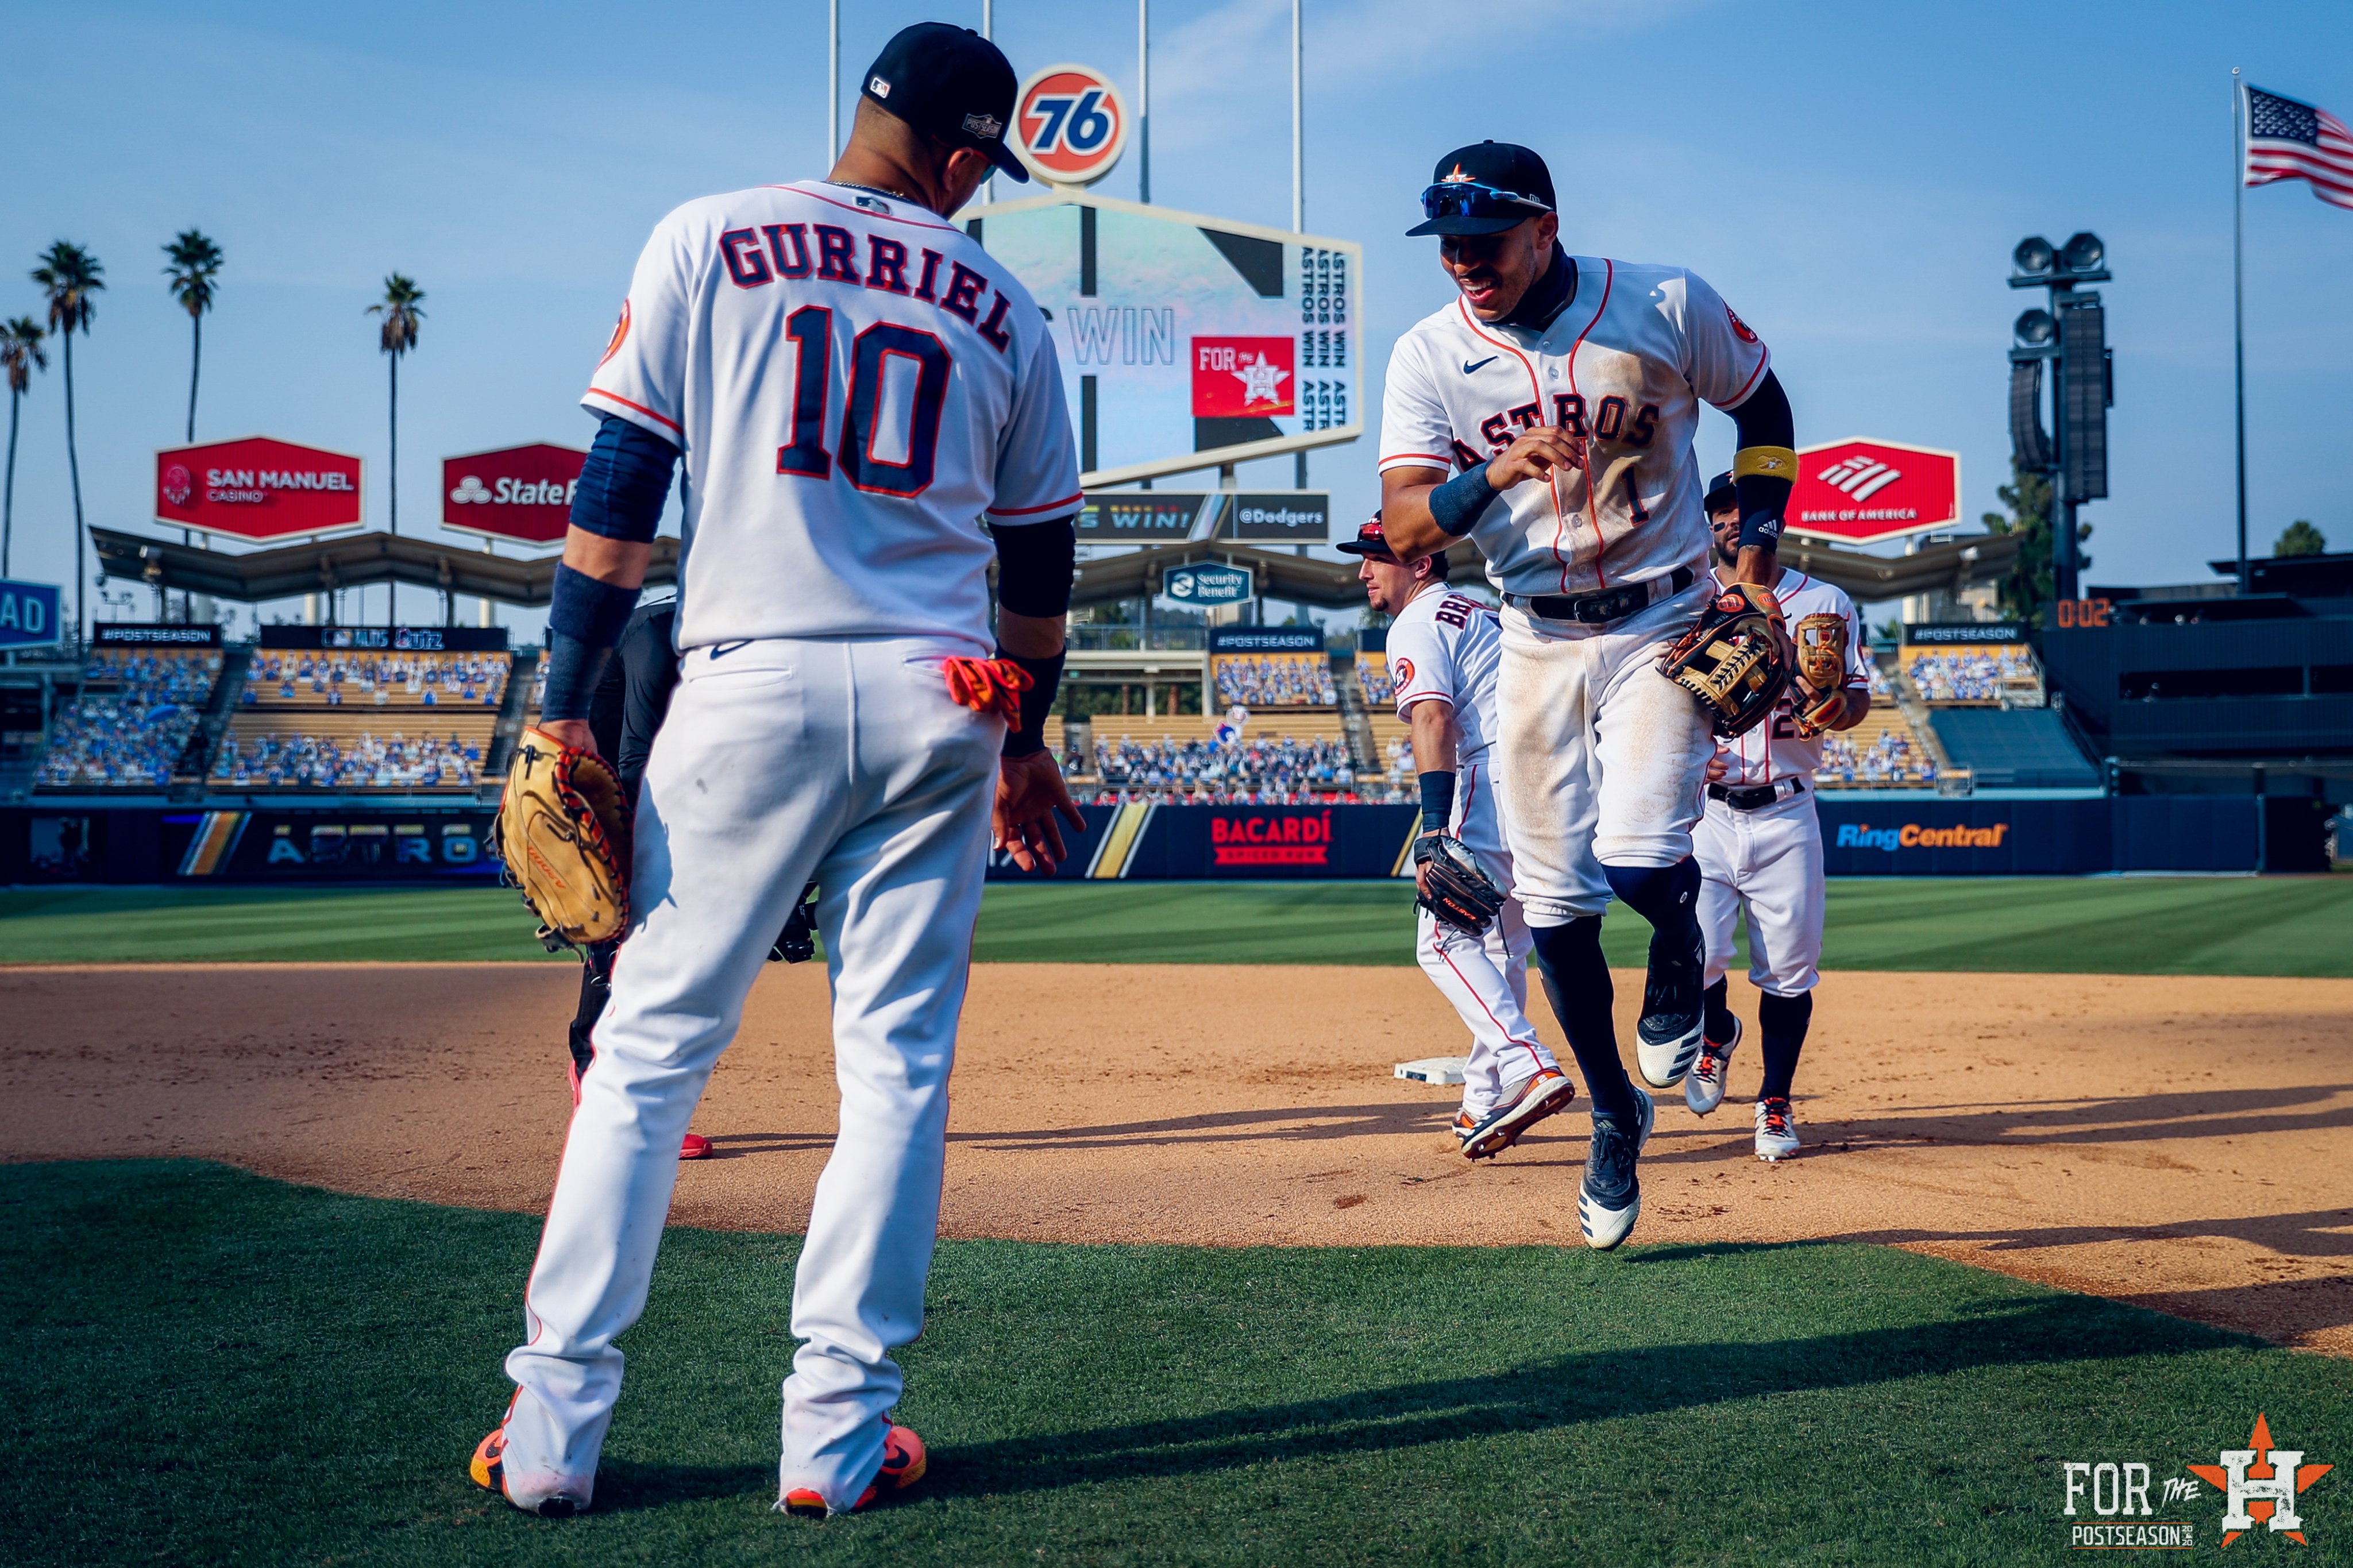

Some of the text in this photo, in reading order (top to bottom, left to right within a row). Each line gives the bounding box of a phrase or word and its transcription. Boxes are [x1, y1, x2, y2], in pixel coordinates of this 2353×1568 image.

[1031, 90, 1113, 153] 76
[719, 223, 1011, 354] GURRIEL
[1302, 246, 1314, 326] ASTROS
[1067, 306, 1175, 365] WIN
[1303, 330, 1314, 366] WIN
[1318, 330, 1330, 366] WIN
[1334, 330, 1345, 366] WIN
[1199, 346, 1236, 371] FOR
[776, 304, 952, 498] 10
[1452, 393, 1660, 472] ASTROS
[206, 468, 354, 491] SAN MANUEL
[206, 489, 263, 503] CASINO
[1621, 464, 1649, 526] 1
[1110, 505, 1191, 529] WIN!
[1239, 507, 1324, 527] @Dodgers
[1802, 508, 1918, 522] BANK OF AMERICA
[1758, 526, 1778, 539] adidas
[1197, 572, 1243, 588] Security
[1198, 585, 1237, 597] Benefit
[2058, 597, 2111, 628] 0:02
[100, 629, 211, 642] #POSTSEASON
[1217, 635, 1316, 647] #POSTSEASON
[1914, 627, 2017, 641] #POSTSEASON
[1212, 809, 1333, 843] BACARDÍ
[1837, 824, 2005, 851] RingCentral
[268, 825, 503, 863] ASTRO
[1442, 897, 1476, 921] EASTON
